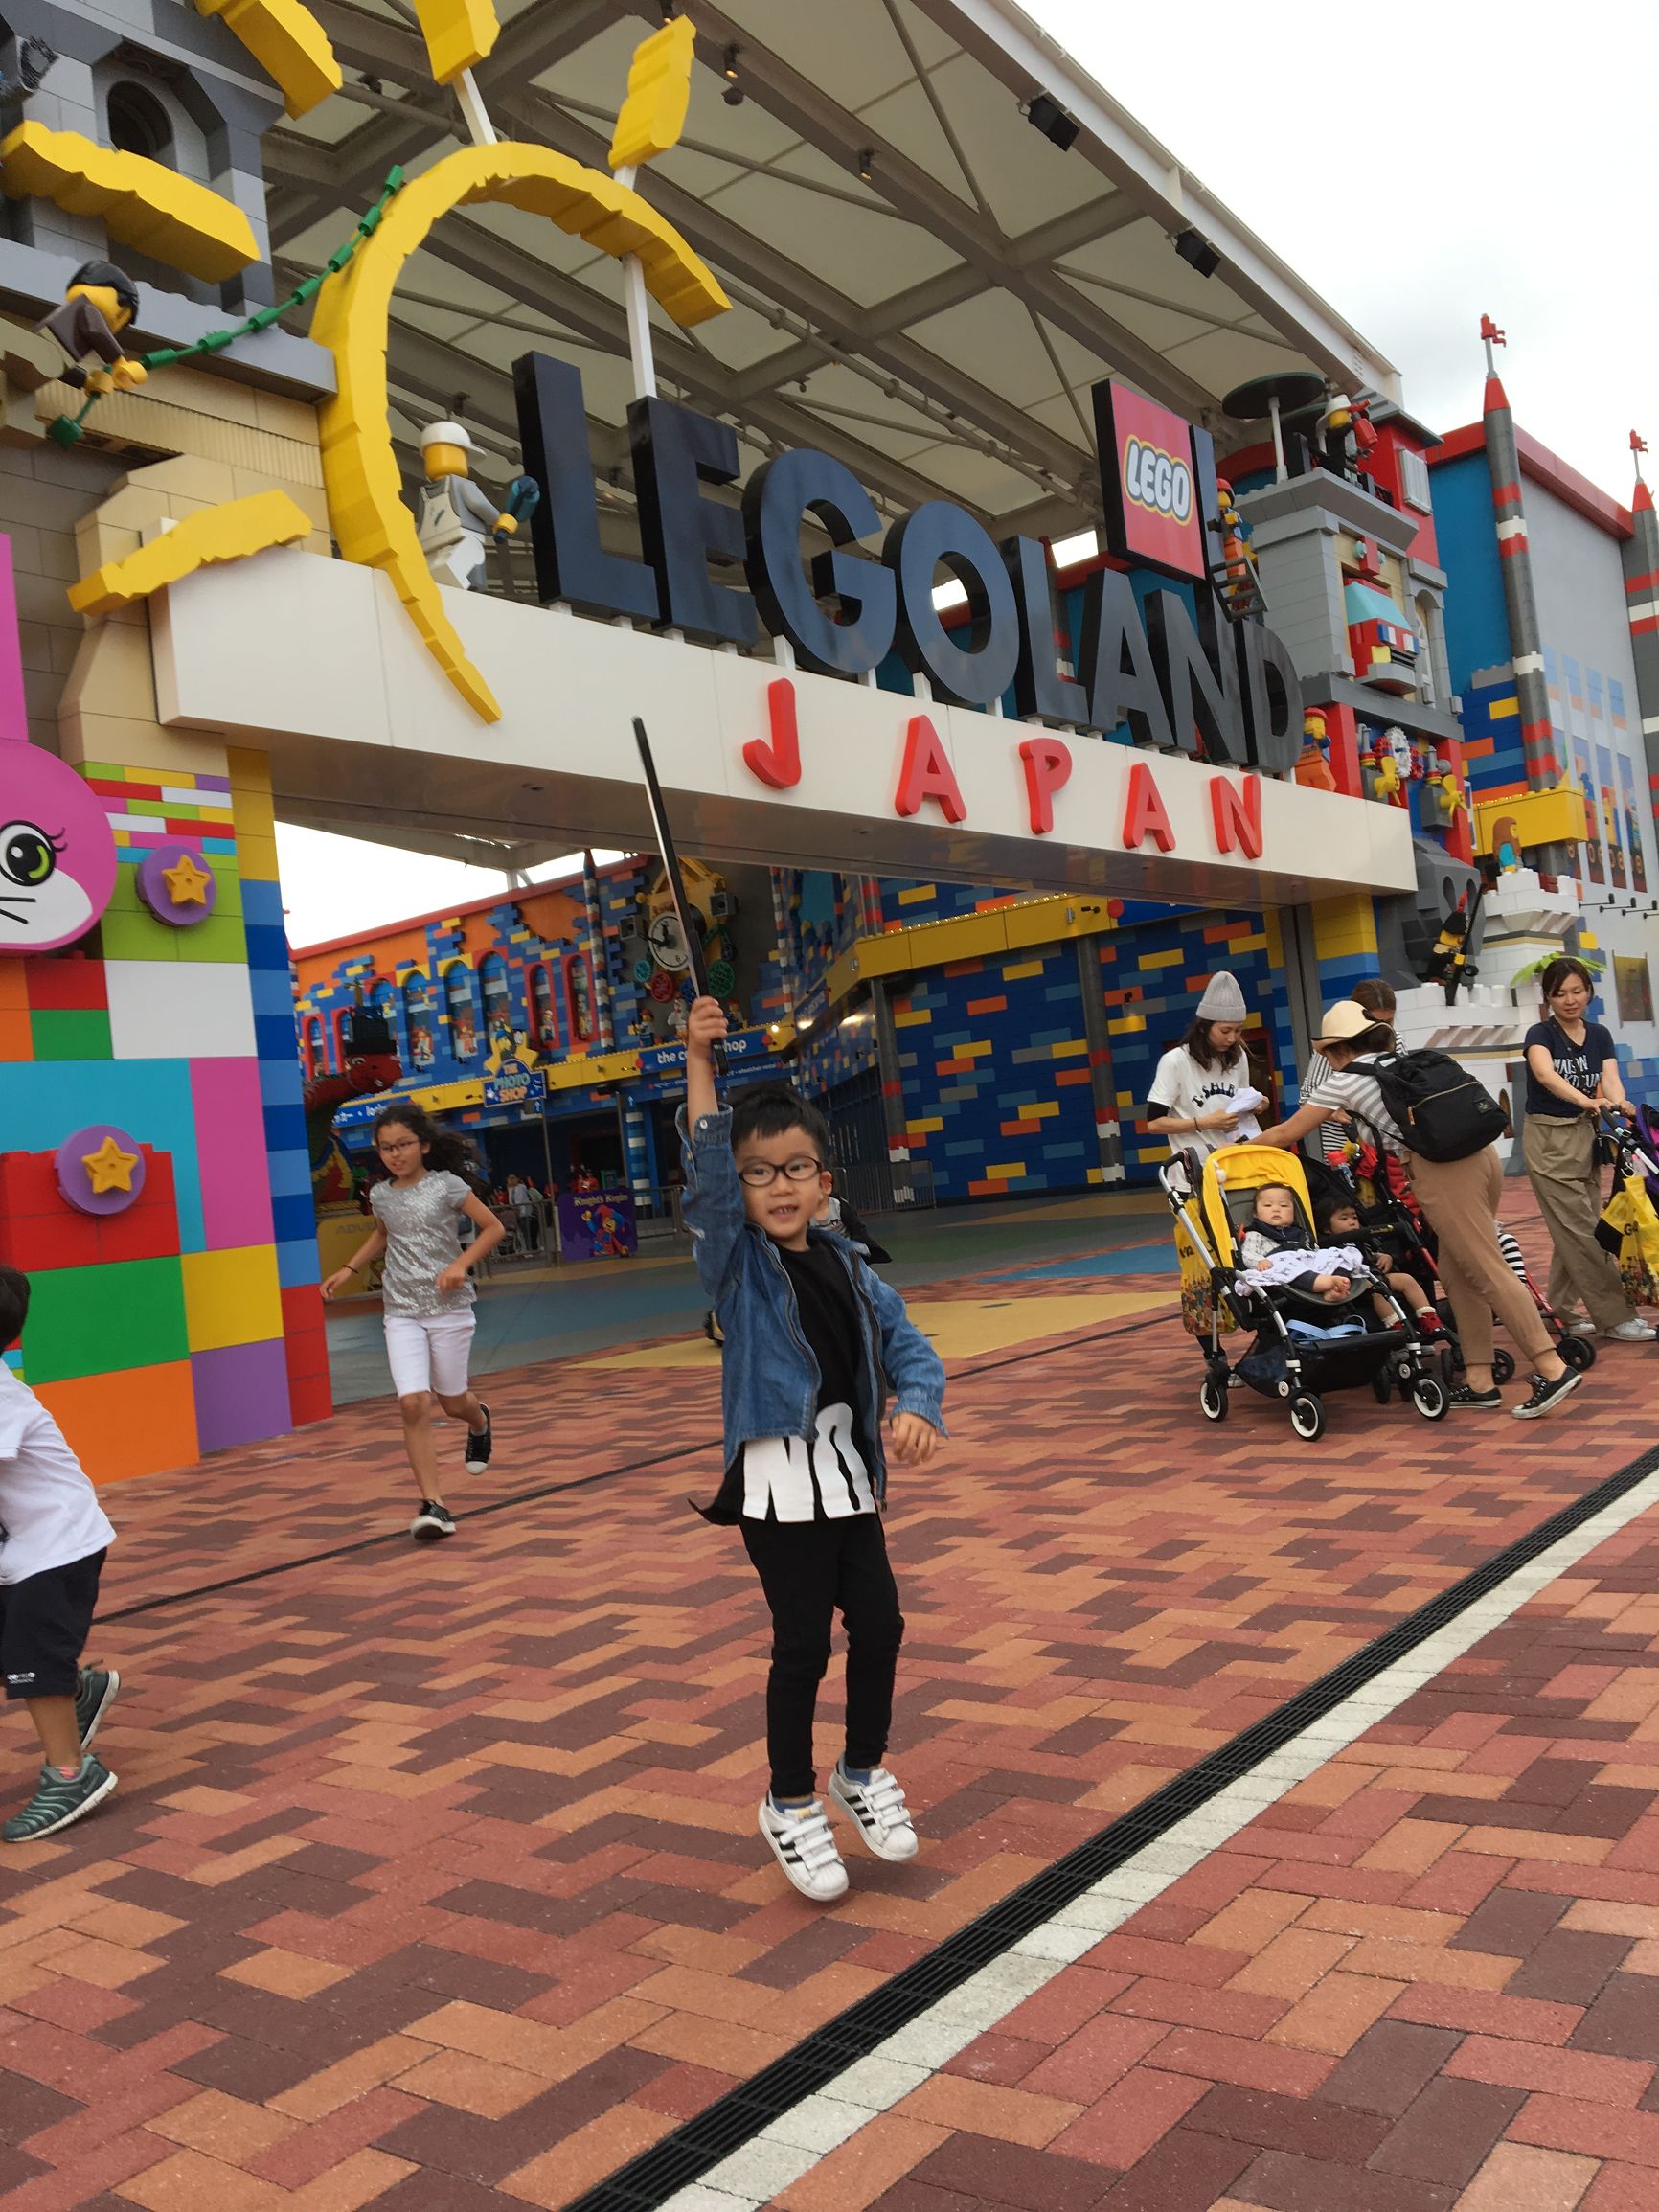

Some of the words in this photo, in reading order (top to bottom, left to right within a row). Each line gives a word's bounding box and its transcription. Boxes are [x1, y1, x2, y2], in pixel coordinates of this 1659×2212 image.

[1125, 438, 1191, 522] LEGO
[512, 352, 1303, 773] LEGOLAND
[742, 678, 1262, 859] JAPAN
[657, 1051, 677, 1064] the
[1553, 1055, 1589, 1075] MAISN
[493, 1072, 531, 1091] PHOTO
[499, 1085, 528, 1103] SHOP
[1192, 1081, 1236, 1108] T-SHIR
